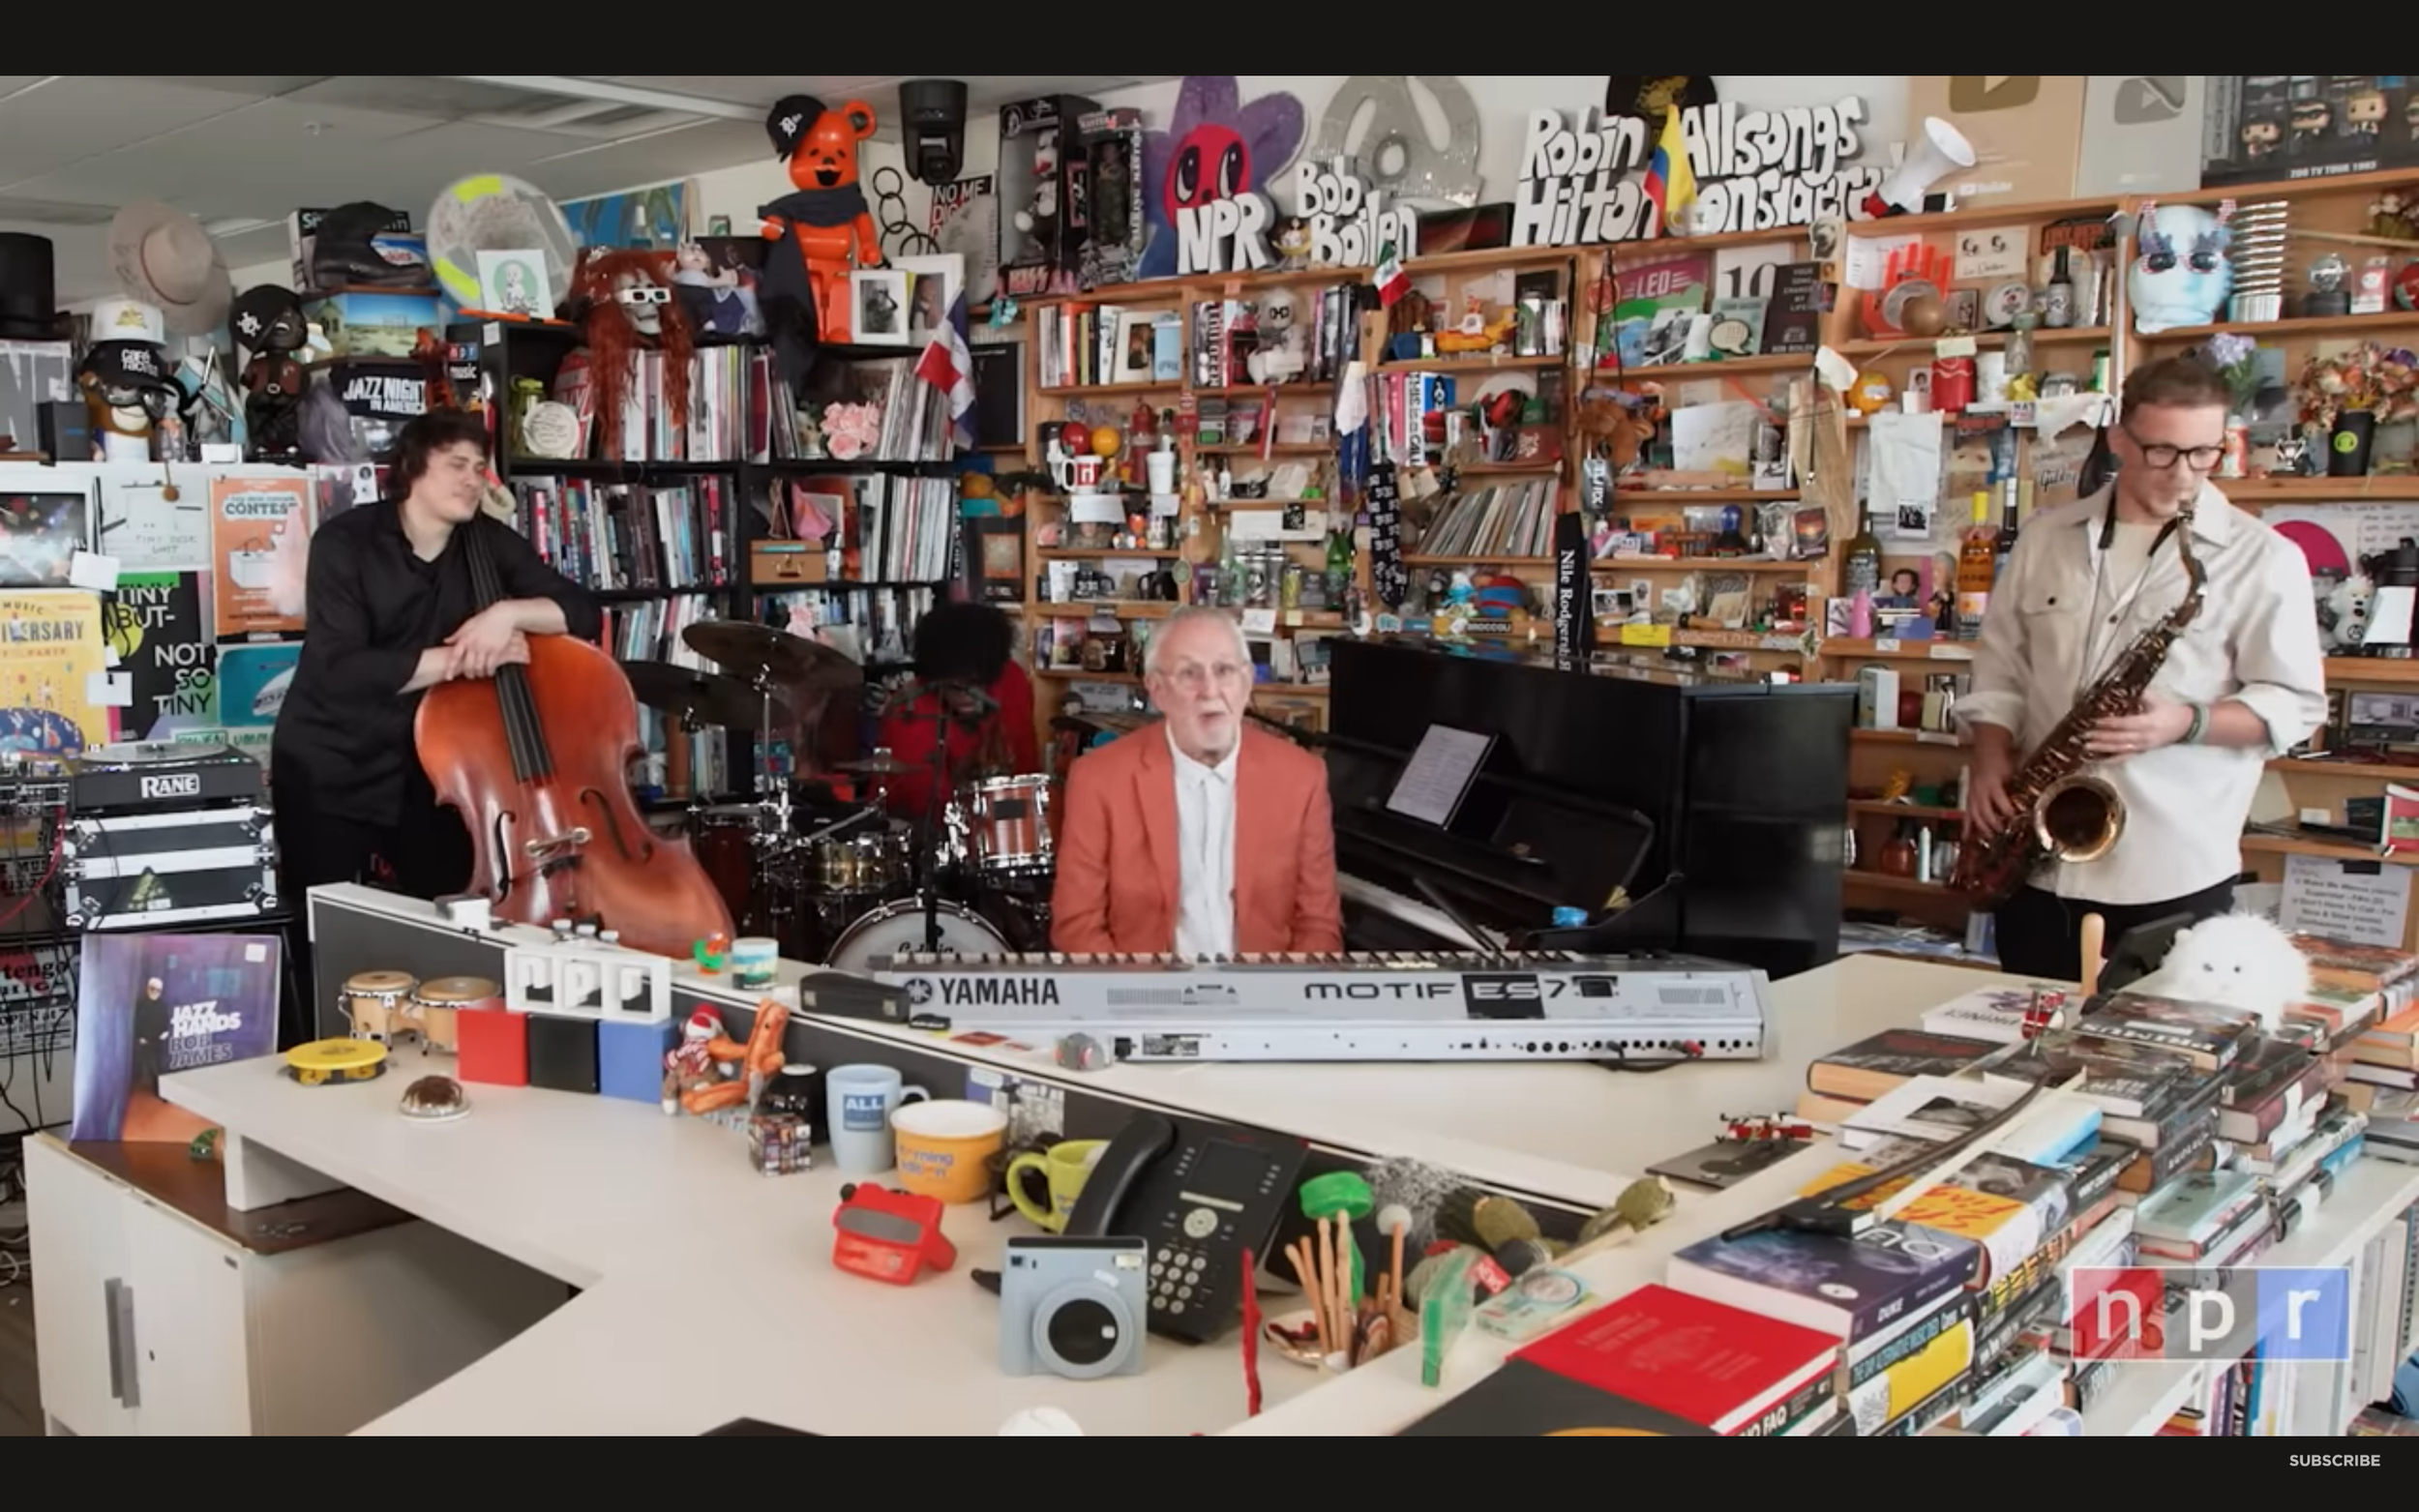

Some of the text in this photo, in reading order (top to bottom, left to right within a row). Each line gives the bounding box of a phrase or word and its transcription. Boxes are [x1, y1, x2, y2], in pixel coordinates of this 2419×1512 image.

[1520, 105, 1645, 181] Robin
[1679, 96, 1863, 188] Allsongs
[934, 184, 957, 203] NO
[1297, 155, 1360, 218] Bob
[1510, 177, 1660, 247] Hilton
[1176, 193, 1269, 275] NPR
[1311, 191, 1419, 267] Boilen
[343, 376, 427, 401] JAZZ NIGHT
[1561, 548, 1575, 584] Nile
[115, 582, 174, 604] TINY
[116, 606, 175, 630] BUT-
[154, 642, 208, 667] NOT
[175, 667, 211, 691] SO
[153, 693, 212, 716] TINY
[141, 775, 198, 798] RANE
[517, 954, 642, 1008] npr
[939, 978, 1060, 1006] YAMAHA
[1303, 982, 1457, 1000] MOTIF
[170, 1000, 217, 1024] JAZZ
[173, 1012, 242, 1039] HANDS
[2082, 1023, 2217, 1052] PRIMUS
[168, 1034, 212, 1055] BOB
[169, 1043, 234, 1070] JAMES
[845, 1096, 882, 1112] ALL
[1878, 1297, 1904, 1323] DUKE
